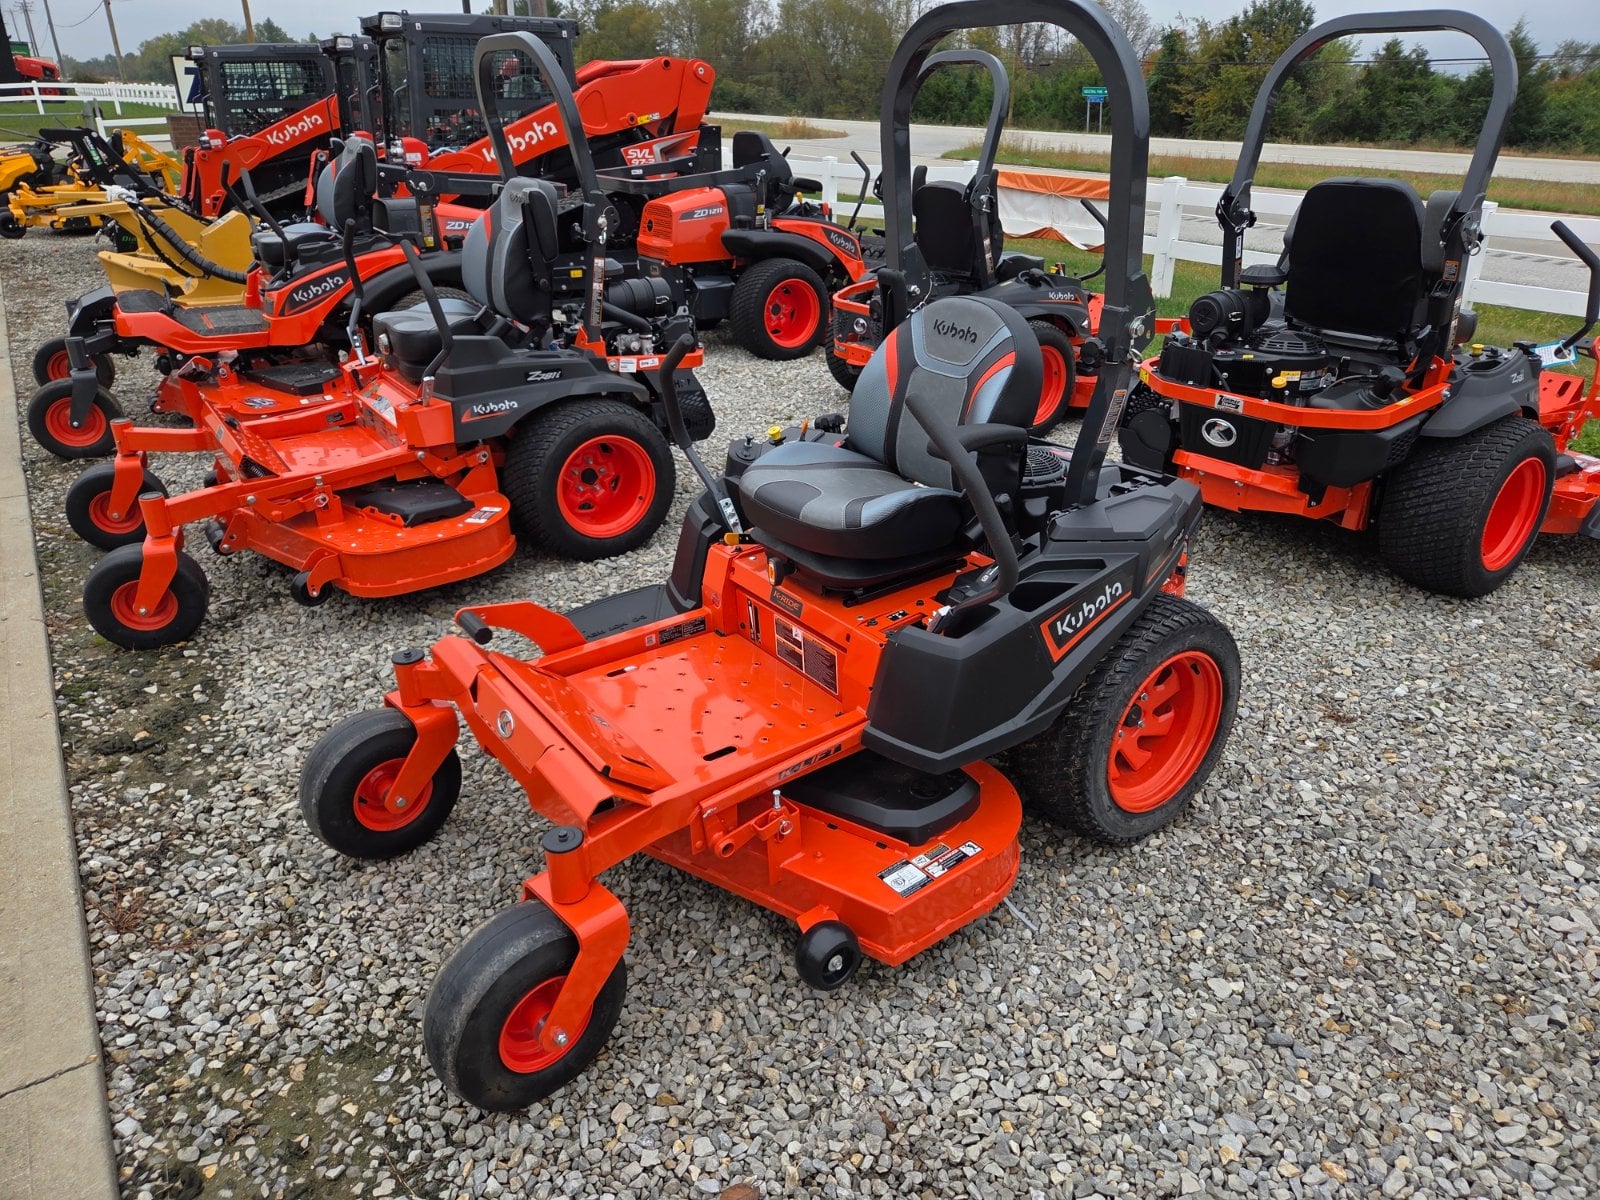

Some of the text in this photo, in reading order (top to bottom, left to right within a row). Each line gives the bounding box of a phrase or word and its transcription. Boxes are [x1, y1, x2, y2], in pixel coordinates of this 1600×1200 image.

[266, 114, 323, 145] Kubota
[626, 148, 654, 159] SVL
[830, 232, 855, 253] Kubota
[293, 276, 344, 302] Kubota
[1048, 291, 1075, 301] Kubota
[933, 319, 978, 344] Kubota
[473, 400, 519, 414] Kubota
[773, 590, 800, 611] K-RIDE
[1056, 581, 1123, 636] Kubota
